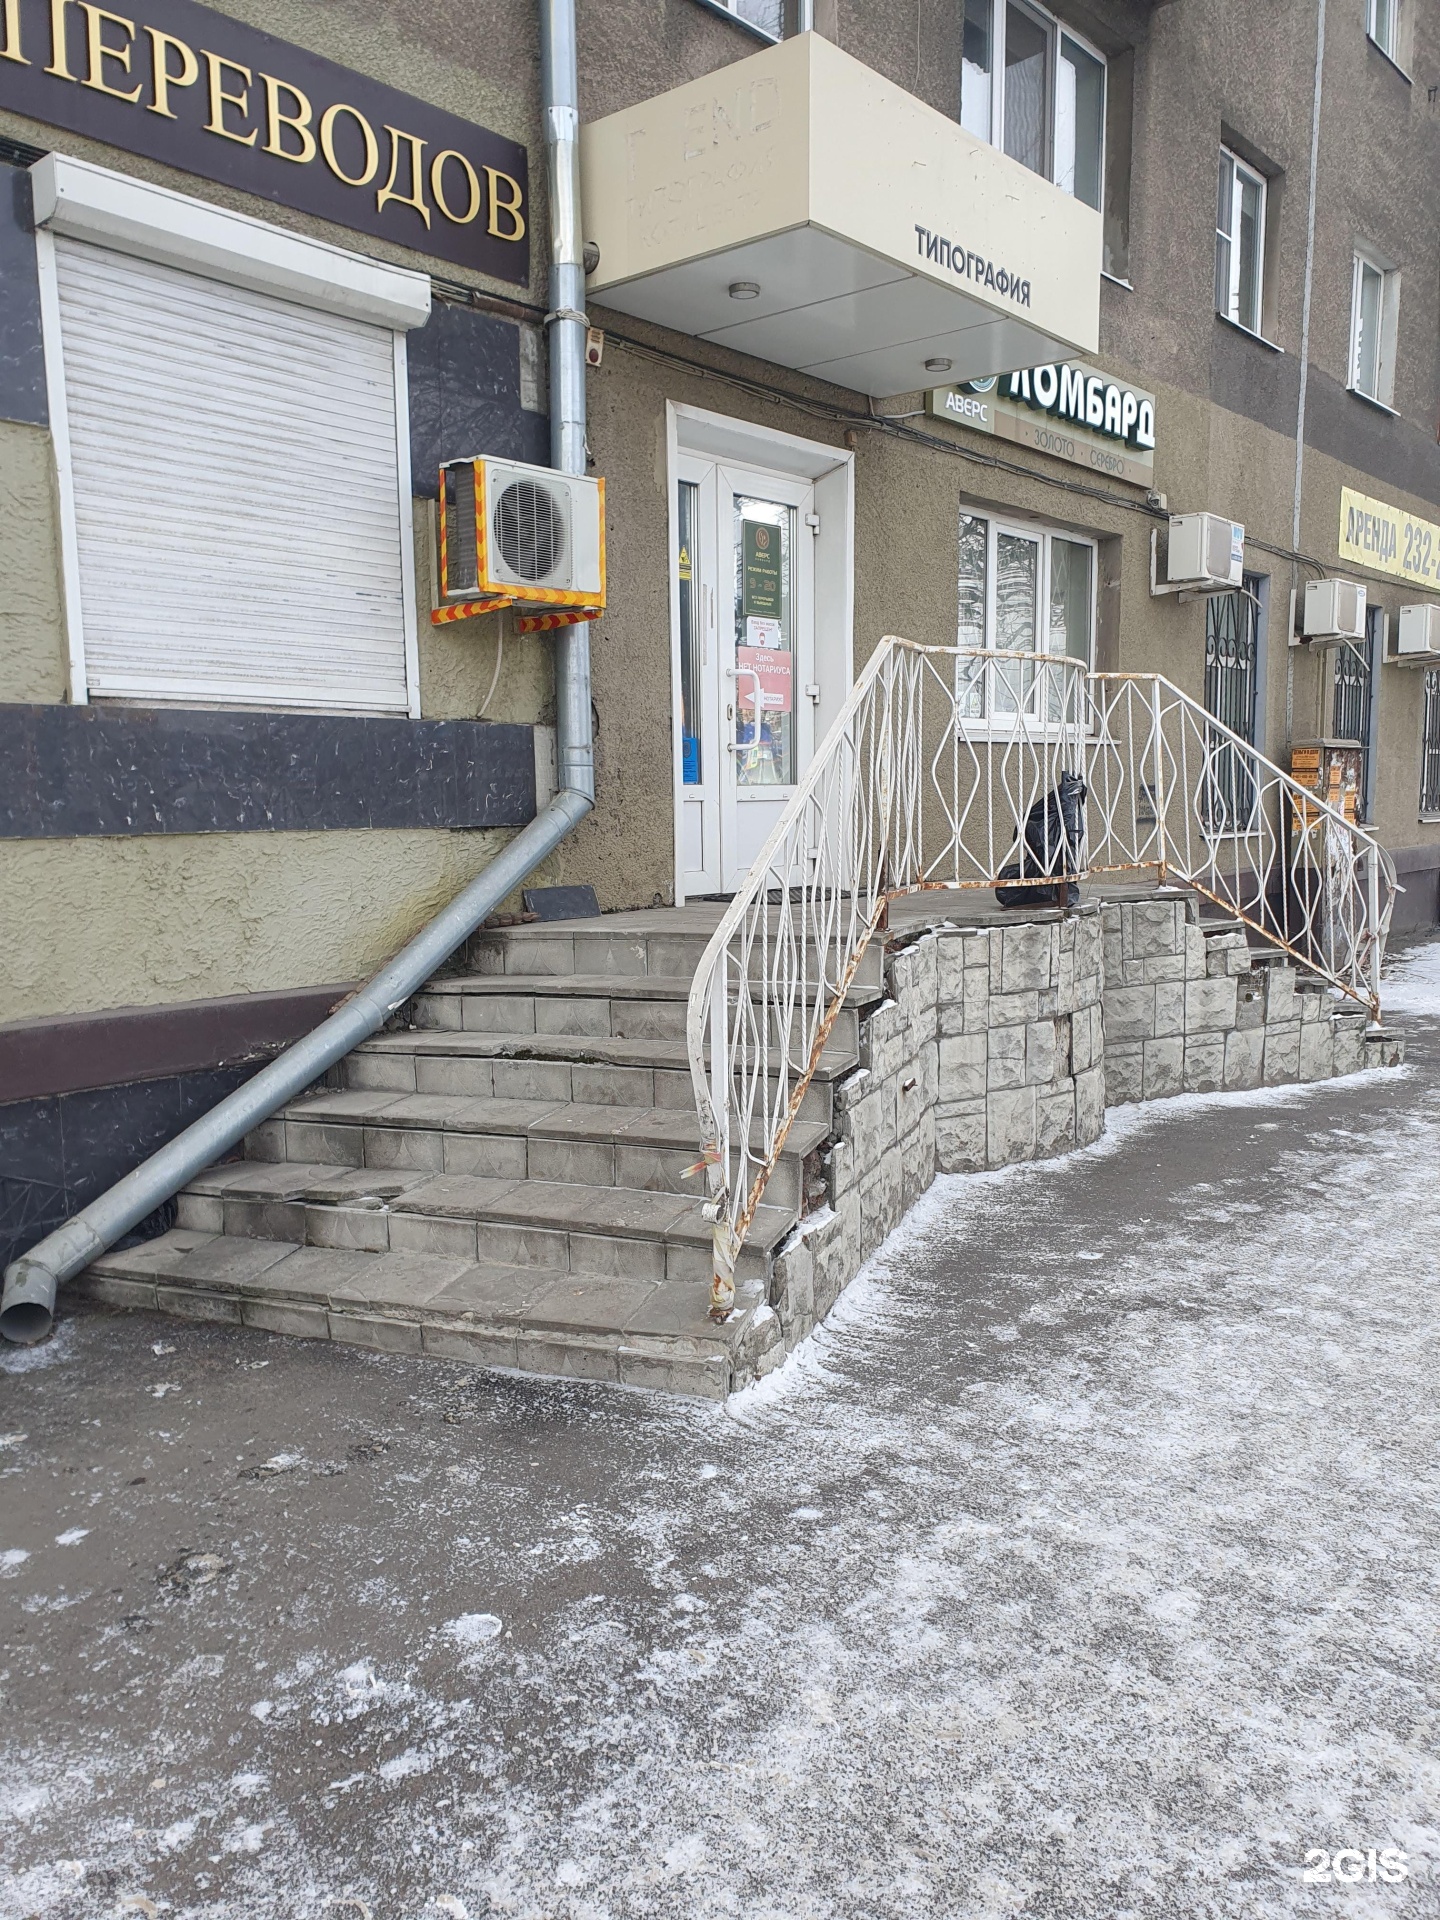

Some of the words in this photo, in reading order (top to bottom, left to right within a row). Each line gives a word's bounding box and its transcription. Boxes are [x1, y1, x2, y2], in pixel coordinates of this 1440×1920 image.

[914, 223, 1031, 309] ТИПОГРАФИЯ
[945, 391, 988, 423] АВЕРС
[1033, 428, 1075, 459] ЗОЛОТО
[1089, 449, 1125, 475] СЕРЕБРО
[1345, 506, 1397, 563] АРЕНДА
[752, 663, 791, 676] НОТАРИУСА
[755, 652, 775, 663] Здесь
